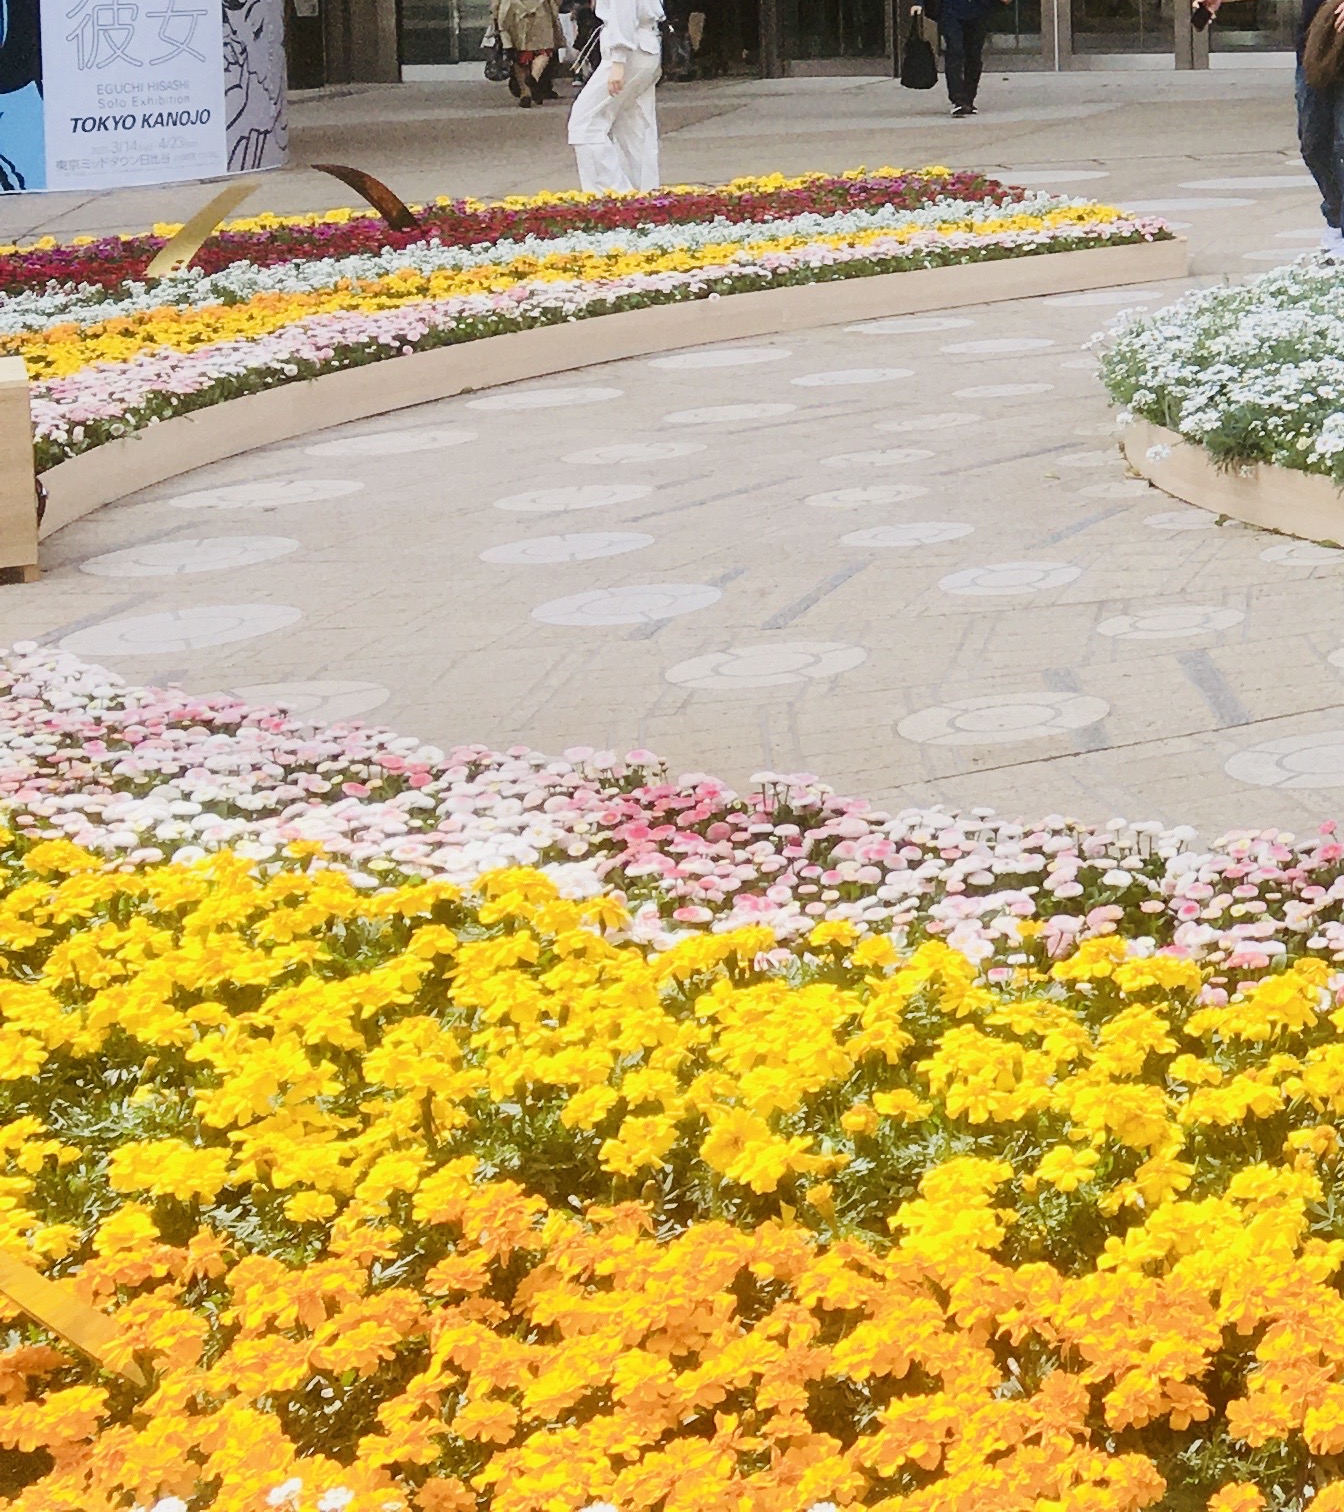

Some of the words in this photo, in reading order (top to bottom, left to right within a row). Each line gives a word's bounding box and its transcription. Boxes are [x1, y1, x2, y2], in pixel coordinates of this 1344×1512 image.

[96, 82, 144, 96] EGUCHI
[97, 98, 127, 109] Solo
[131, 95, 190, 108] Exhibition
[70, 114, 136, 133] TOKYO
[141, 108, 211, 129] KANOJO
